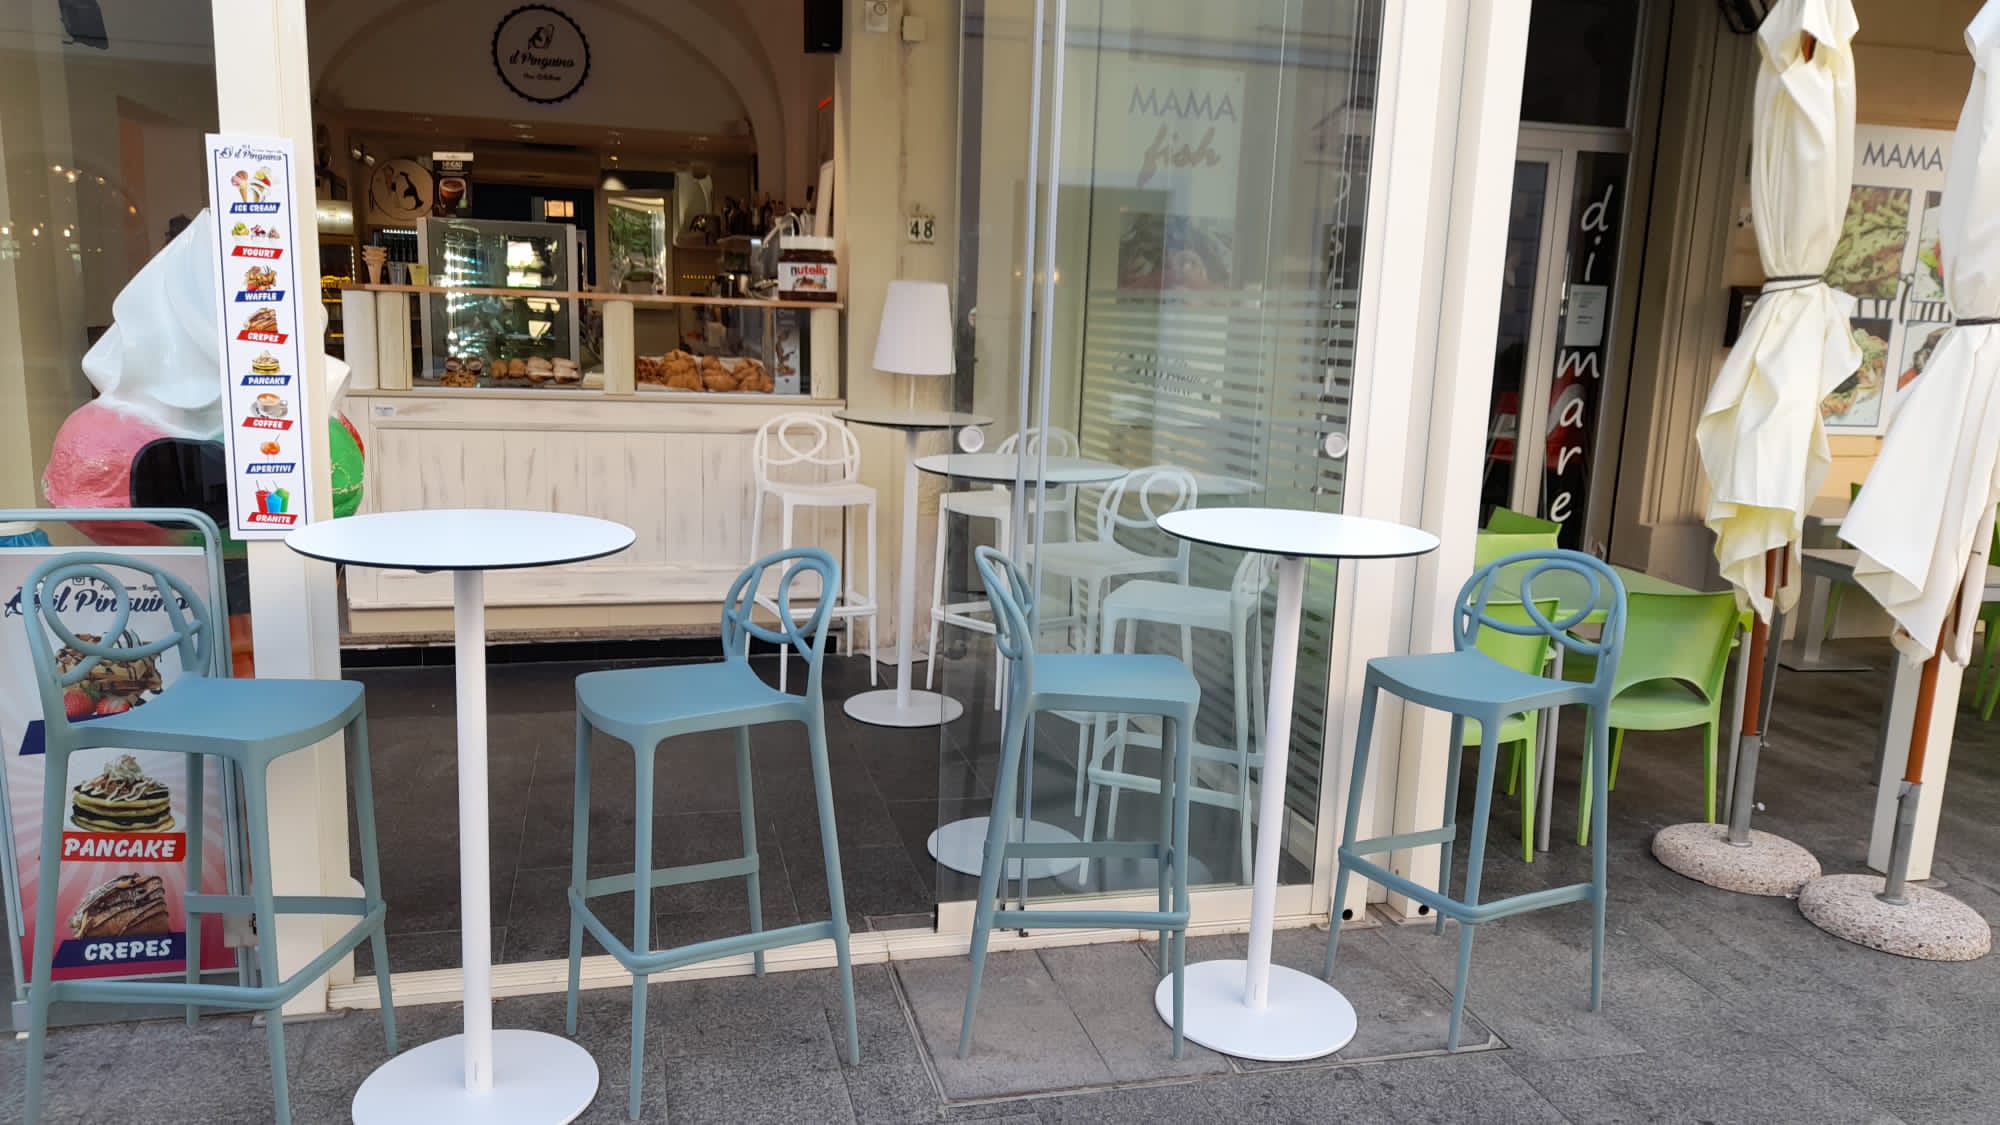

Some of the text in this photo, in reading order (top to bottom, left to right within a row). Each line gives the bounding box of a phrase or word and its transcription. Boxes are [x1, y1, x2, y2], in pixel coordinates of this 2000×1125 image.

[1128, 81, 1239, 124] MAMA
[1862, 140, 1944, 172] MAMA
[234, 204, 277, 212] ICE CREAM
[910, 220, 933, 239] 48
[242, 247, 275, 258] YOGURT
[244, 292, 277, 301] WAFFLE
[247, 332, 280, 343] CREPES
[248, 376, 286, 385] PANCAKE
[252, 419, 284, 429] COFFEE
[250, 464, 292, 473] APERITIVI
[255, 514, 291, 524] GRANITE
[63, 838, 177, 859] PANCAKE
[84, 938, 173, 961] CREPES
